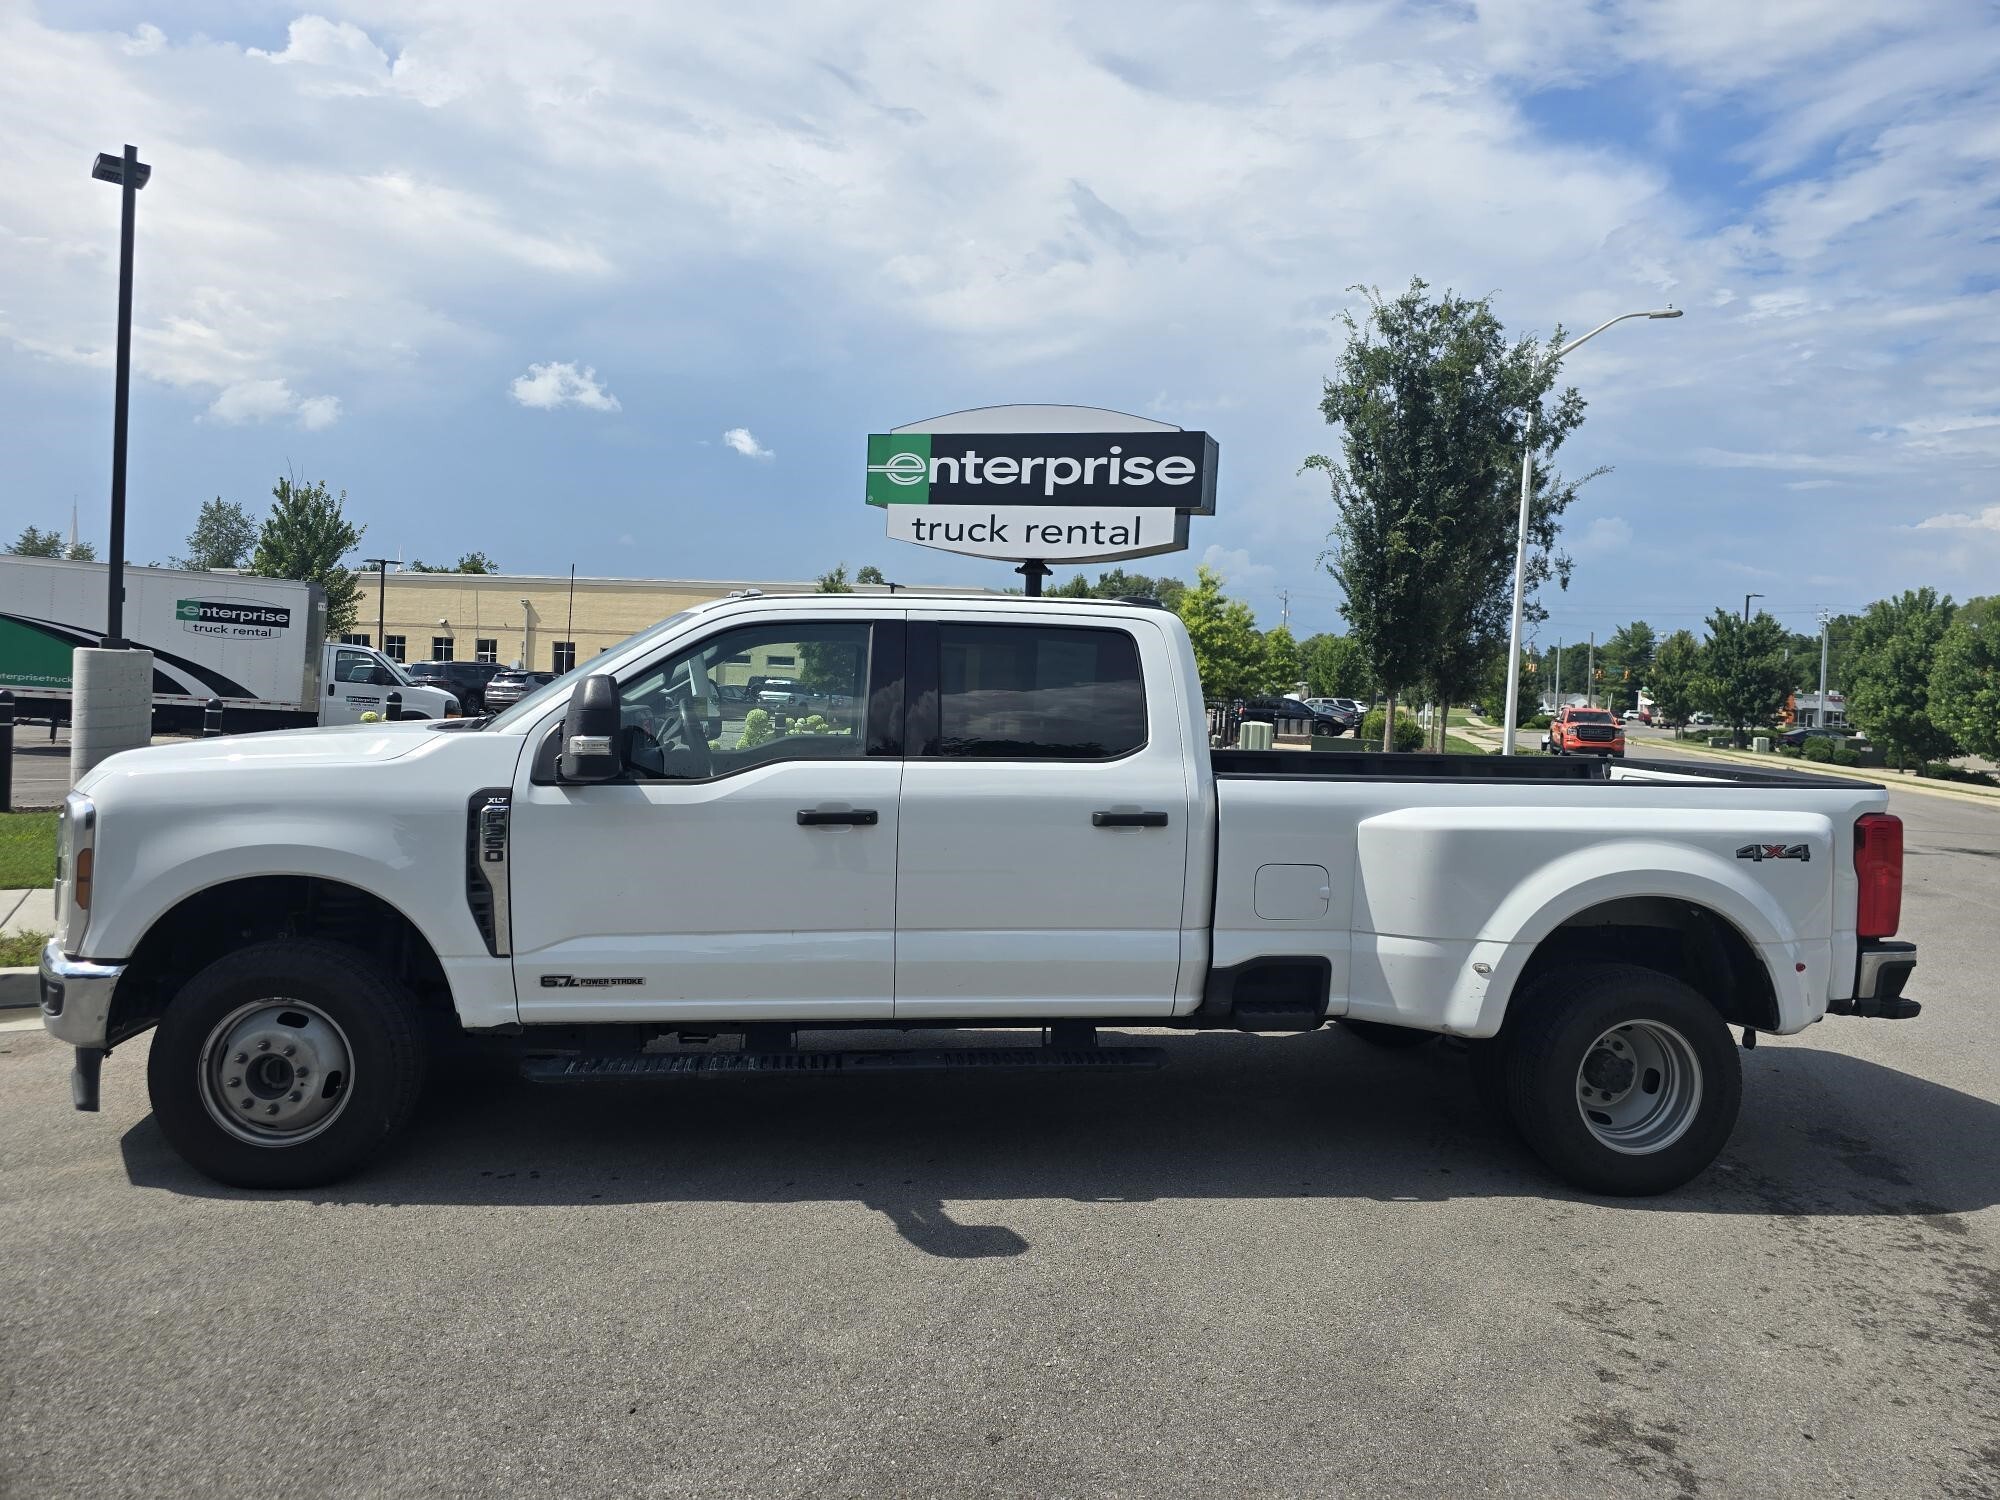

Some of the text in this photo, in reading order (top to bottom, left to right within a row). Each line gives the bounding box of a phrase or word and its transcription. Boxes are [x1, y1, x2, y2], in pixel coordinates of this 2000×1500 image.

[868, 446, 1196, 496] enterprise
[911, 513, 1141, 545] truck rental
[177, 605, 289, 623] enterprise
[192, 623, 273, 637] truck rental
[540, 975, 580, 987] 6.7L
